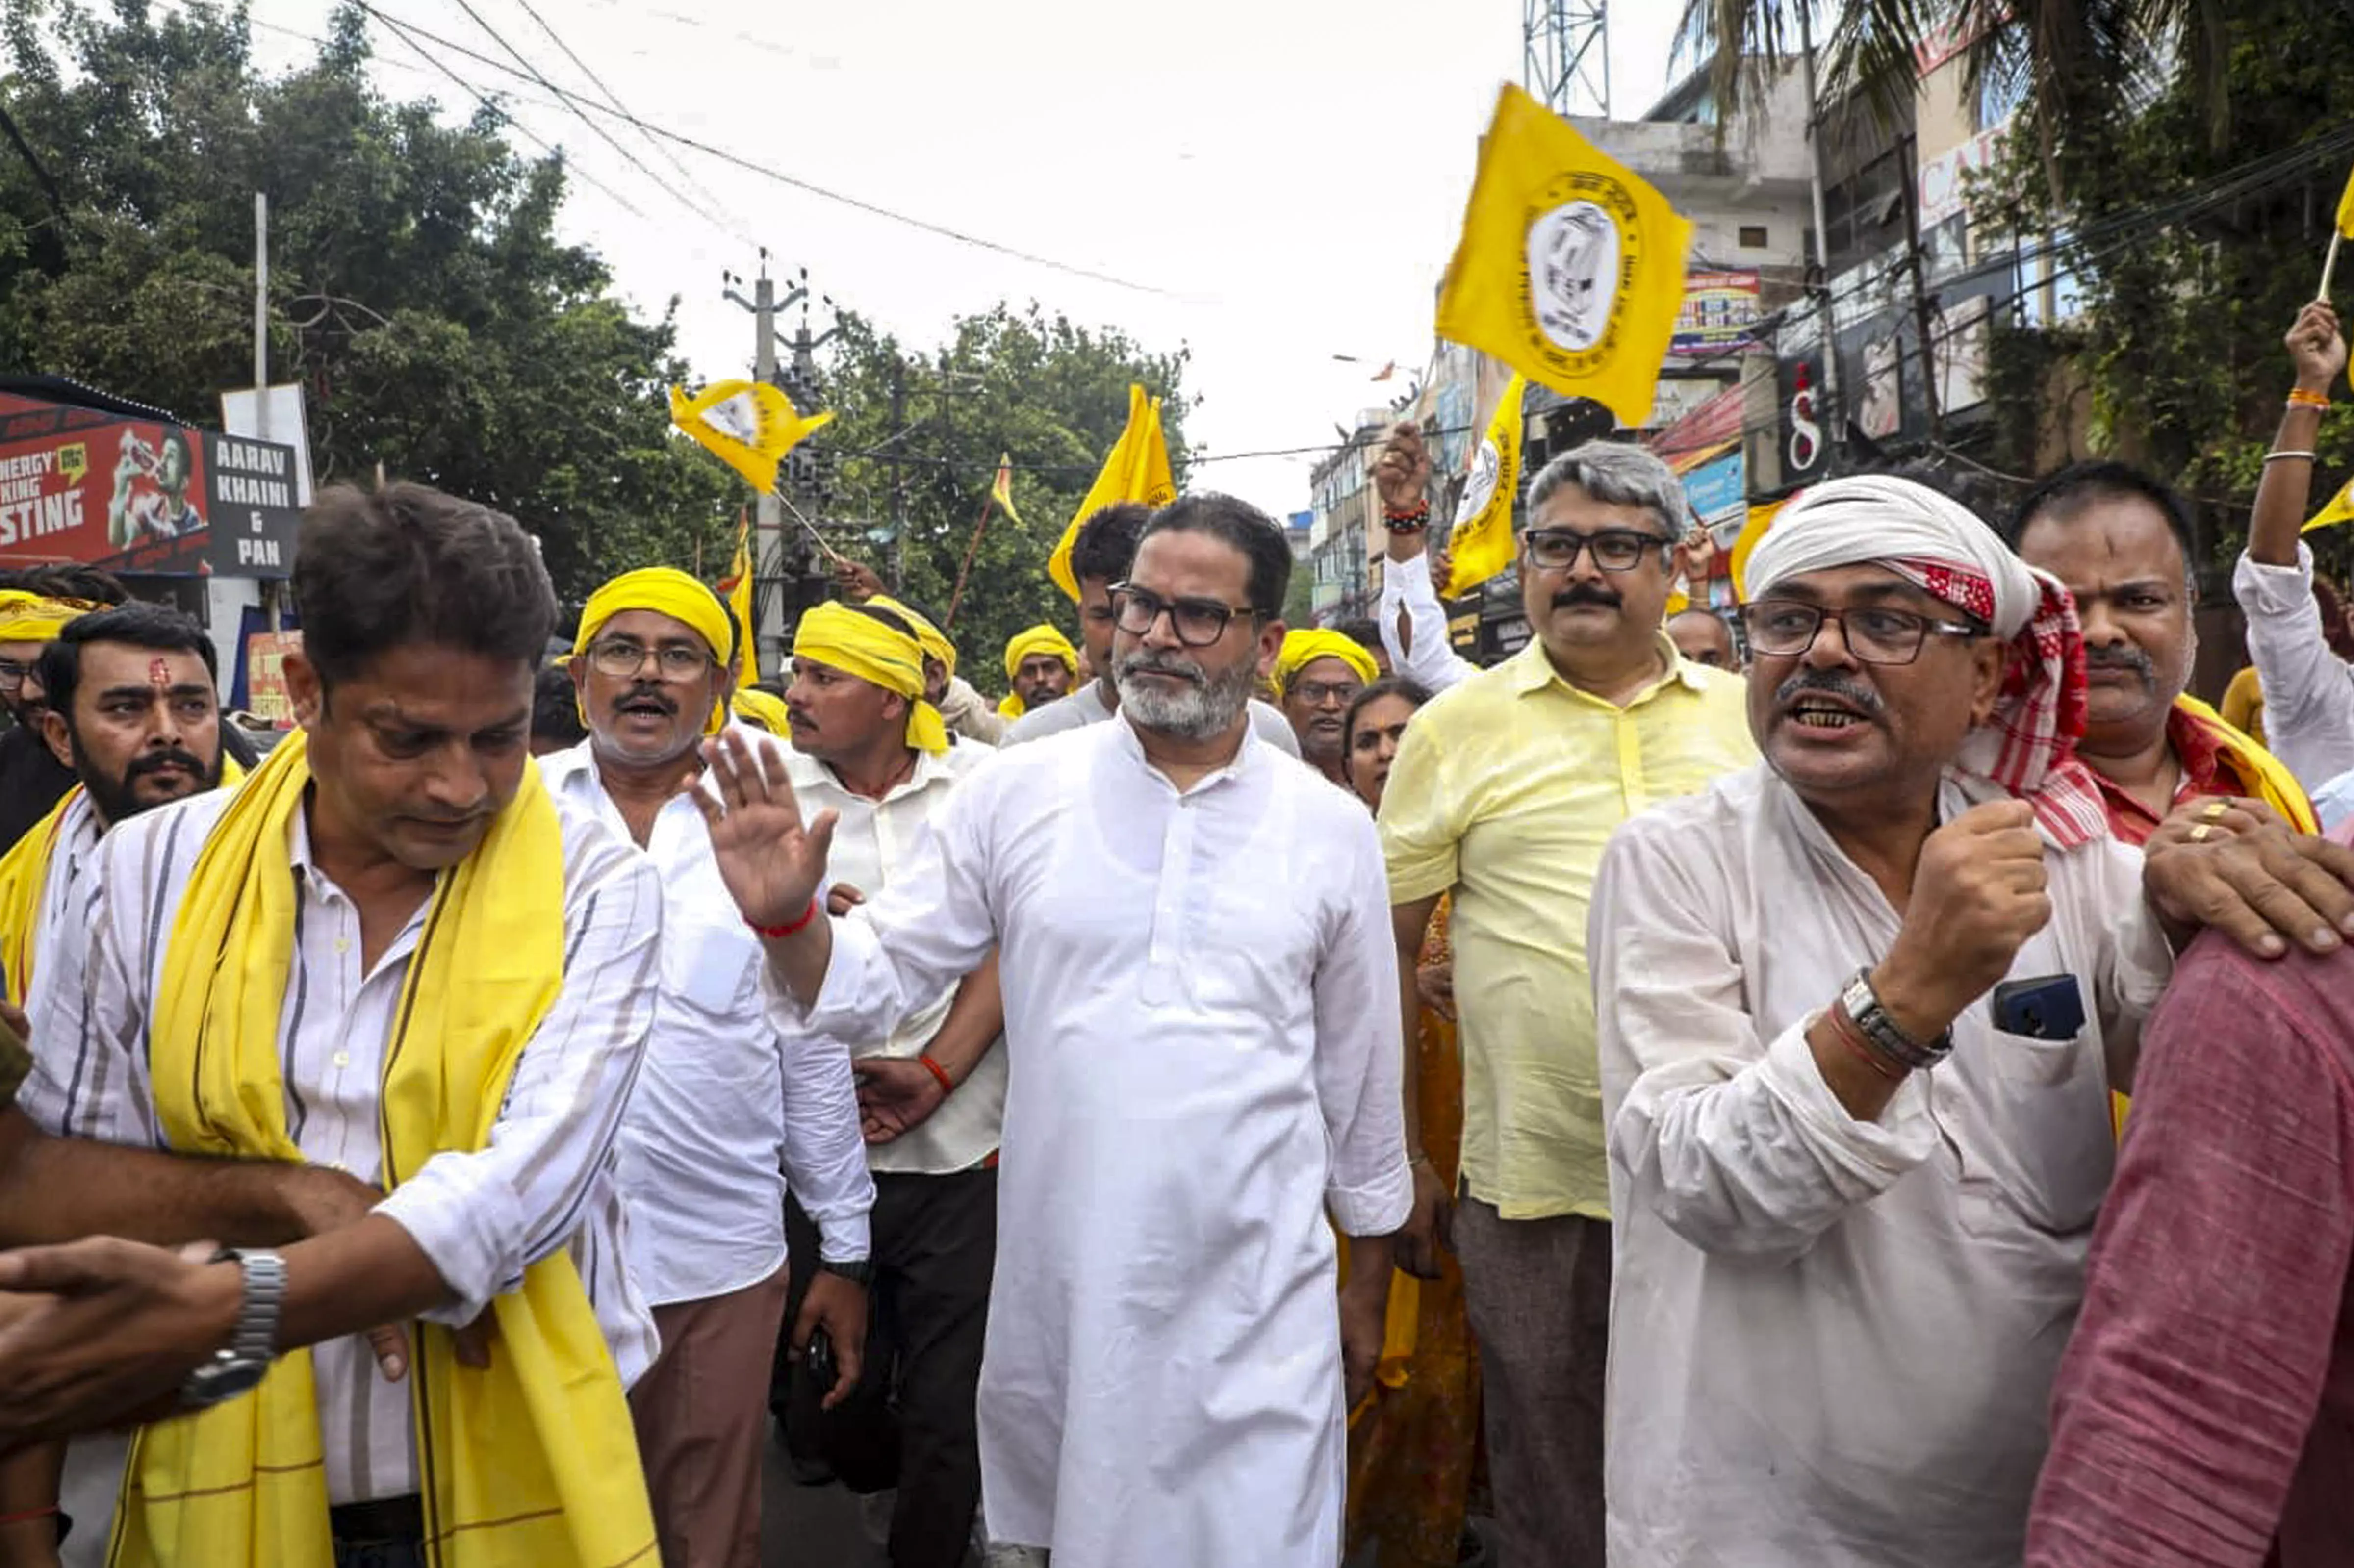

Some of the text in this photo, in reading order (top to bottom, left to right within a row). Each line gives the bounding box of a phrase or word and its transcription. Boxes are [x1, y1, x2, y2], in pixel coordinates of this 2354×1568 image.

[217, 440, 284, 476] AARAV
[1, 477, 41, 504] KING
[217, 474, 290, 508] KHAINI
[0, 490, 83, 547] STING
[238, 539, 280, 566] PAN
